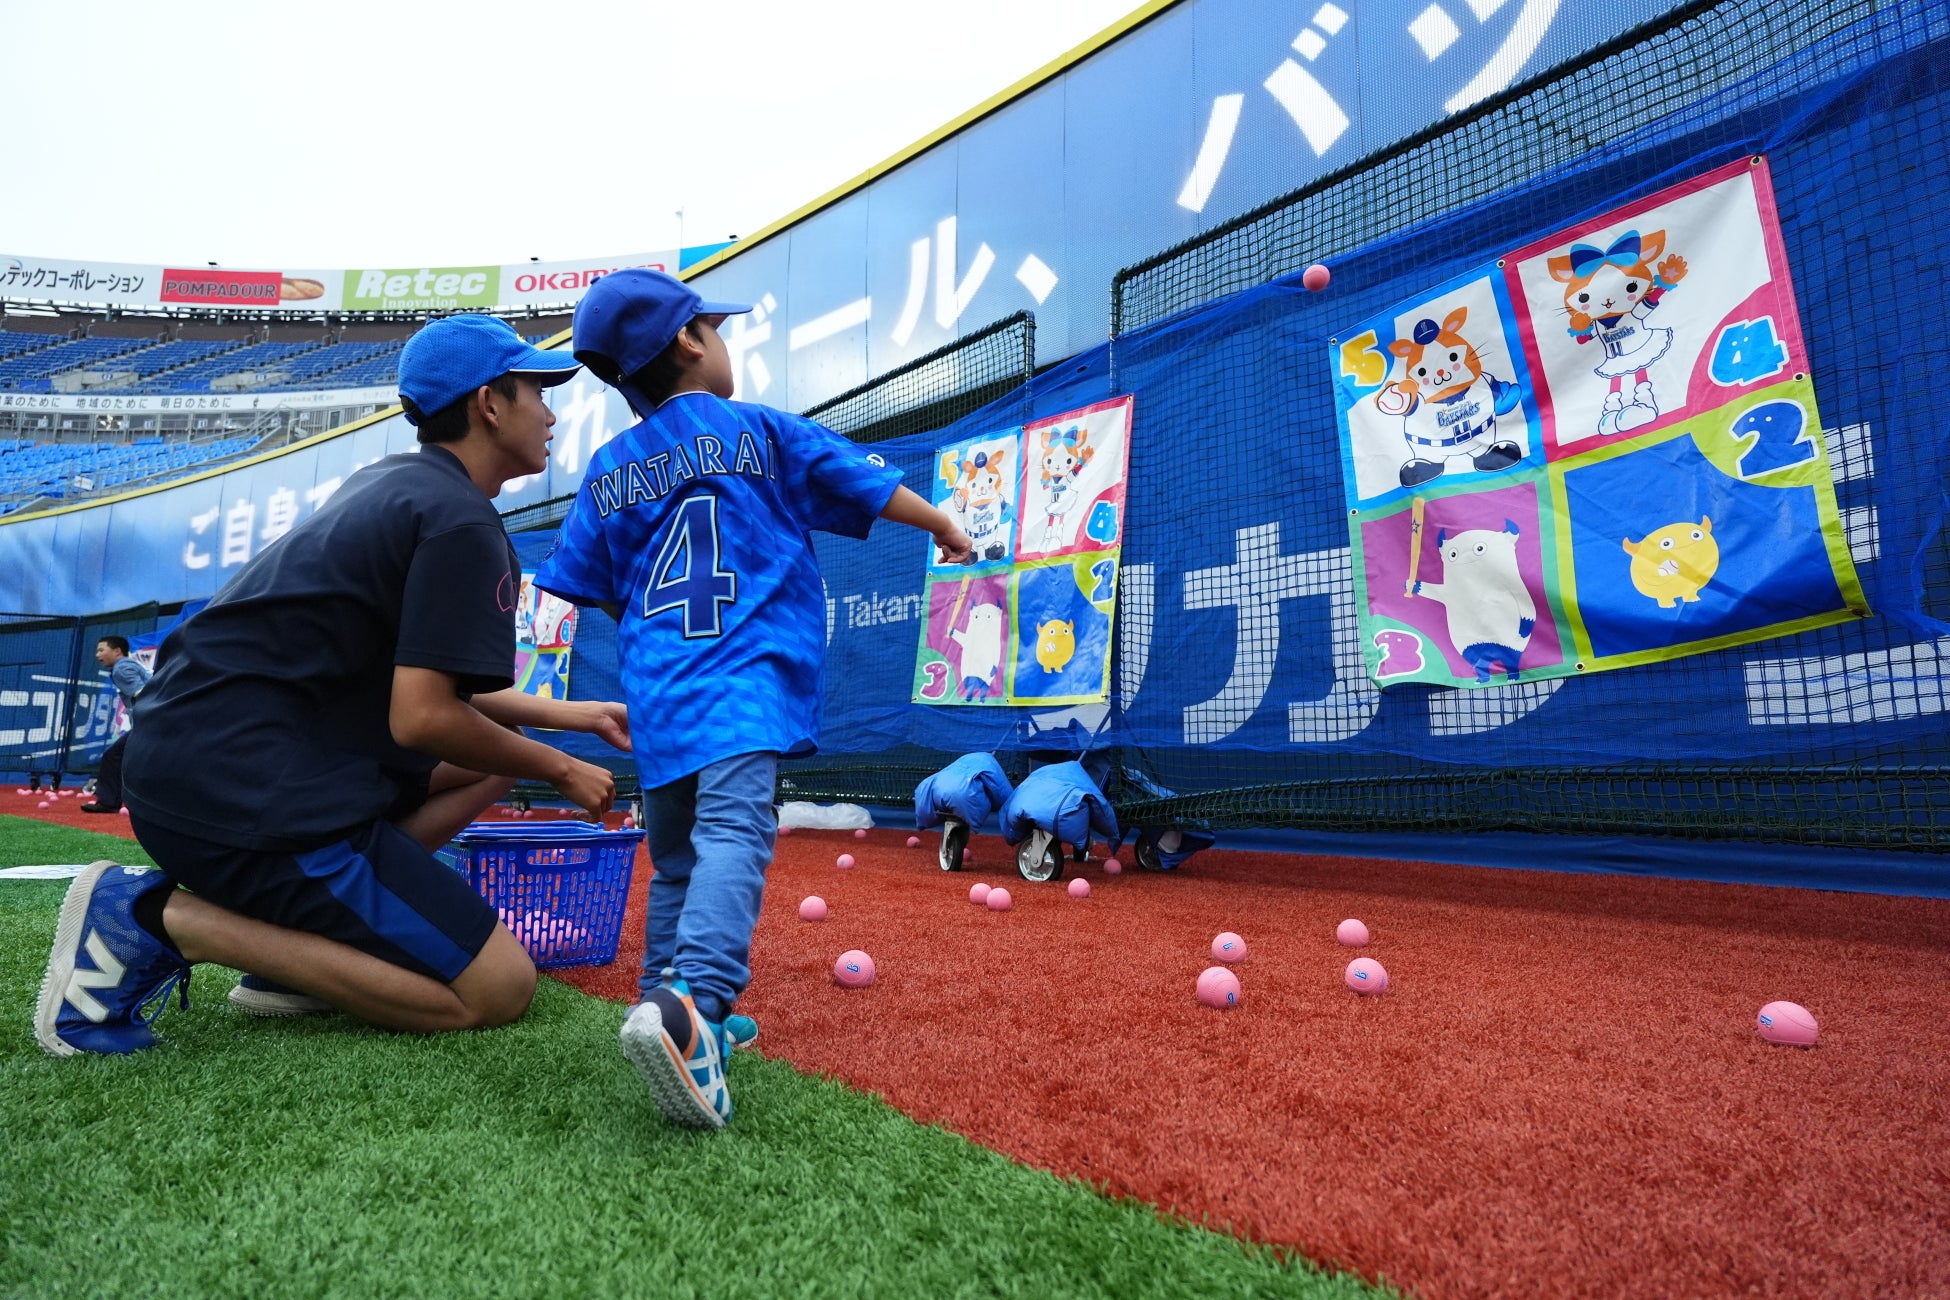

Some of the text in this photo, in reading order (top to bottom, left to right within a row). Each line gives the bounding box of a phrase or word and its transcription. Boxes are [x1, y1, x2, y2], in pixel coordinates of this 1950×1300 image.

[164, 280, 276, 298] POMPADOUR
[354, 268, 488, 298] Retec
[382, 297, 457, 309] Innovation
[1339, 328, 1389, 388] 5
[1709, 315, 1788, 387] 4
[1729, 398, 1821, 480] 2
[591, 433, 775, 517] WATARAI
[939, 449, 959, 490] 5
[1085, 500, 1119, 545] 4
[644, 495, 735, 638] 4
[1090, 557, 1115, 605] 2
[842, 591, 925, 629] Takan
[1373, 628, 1424, 679] 3
[919, 660, 949, 700] 3
